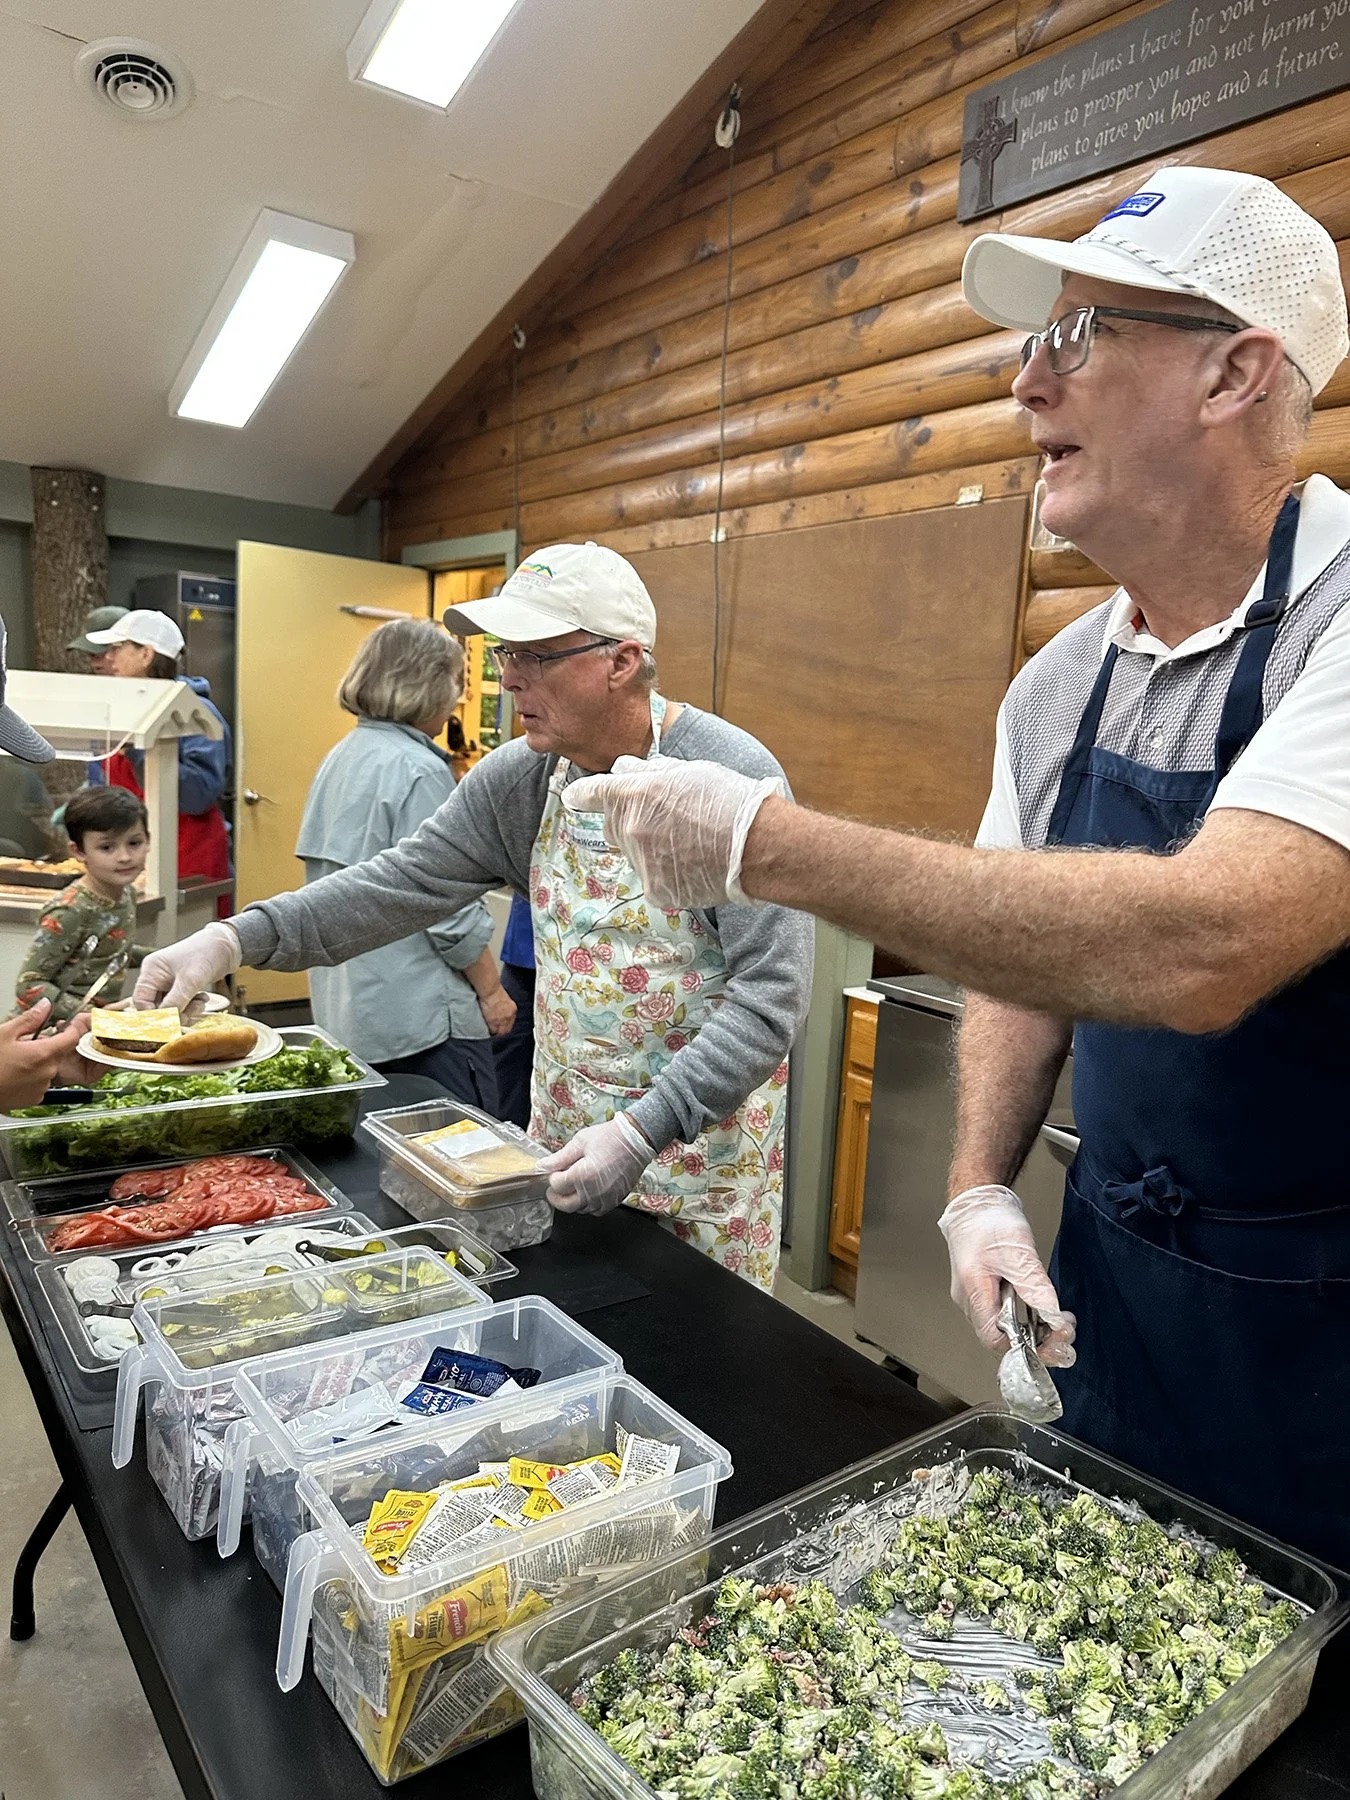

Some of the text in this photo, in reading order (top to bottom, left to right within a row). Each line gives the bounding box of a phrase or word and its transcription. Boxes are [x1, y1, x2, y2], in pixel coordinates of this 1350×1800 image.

[1011, 87, 1049, 114] know
[1053, 64, 1076, 97] the
[1080, 51, 1122, 92] plans
[1128, 44, 1136, 64] I
[1140, 28, 1181, 63] have
[1187, 7, 1212, 47] for
[1219, 0, 1254, 34] you
[1020, 0, 1350, 150] plans to prosper you and not harm yo
[1030, 41, 1344, 179] plans to give you hope and a future.
